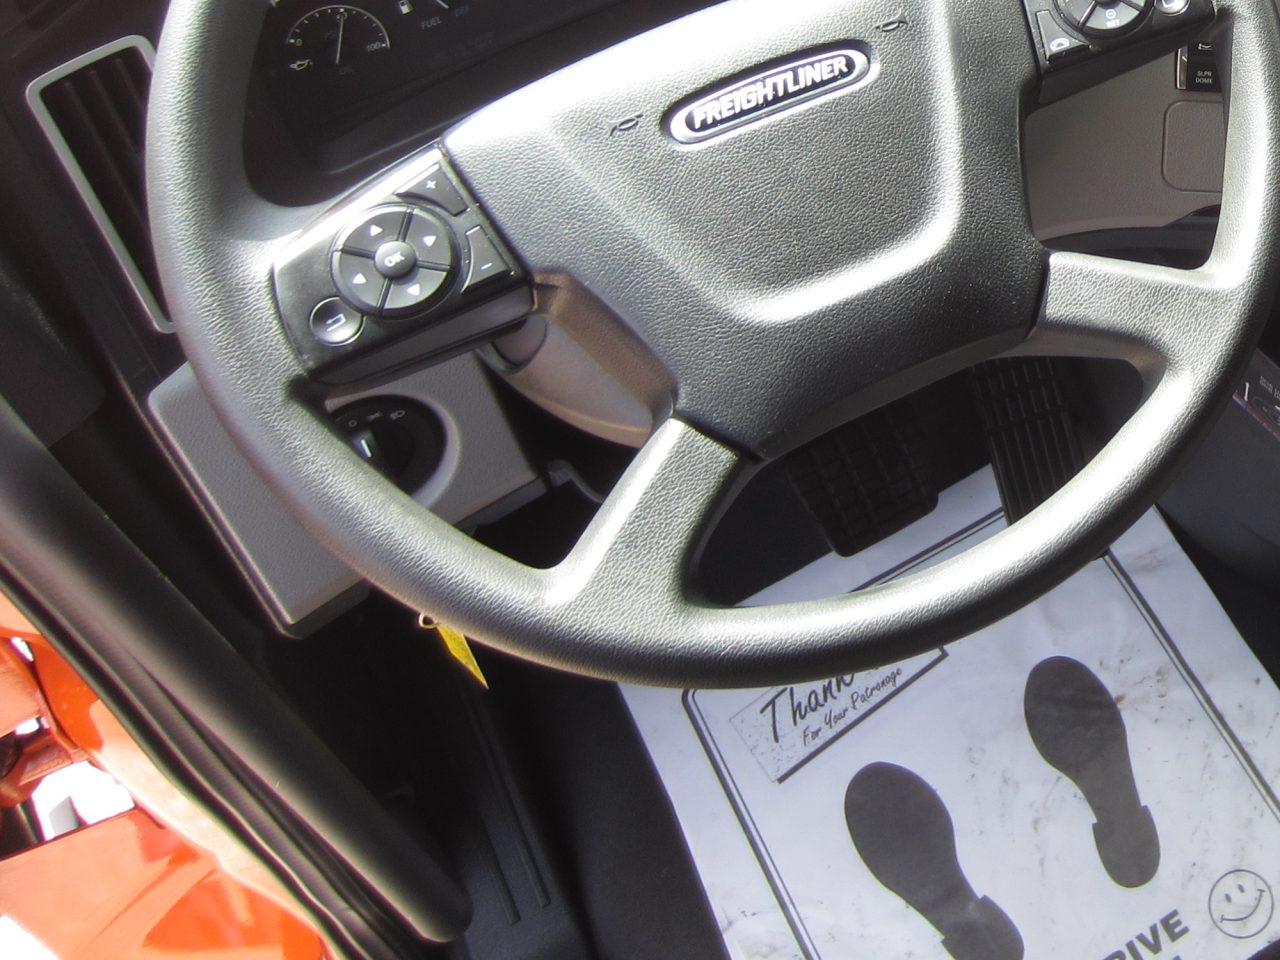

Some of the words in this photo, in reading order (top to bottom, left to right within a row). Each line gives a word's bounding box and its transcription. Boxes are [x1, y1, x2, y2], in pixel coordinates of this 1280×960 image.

[420, 16, 442, 30] FUEL
[366, 41, 381, 52] 100
[692, 55, 849, 129] FREIGHTLINER
[383, 251, 405, 268] OK
[802, 725, 822, 747] For
[824, 707, 849, 730] Your
[851, 667, 903, 711] Patronage
